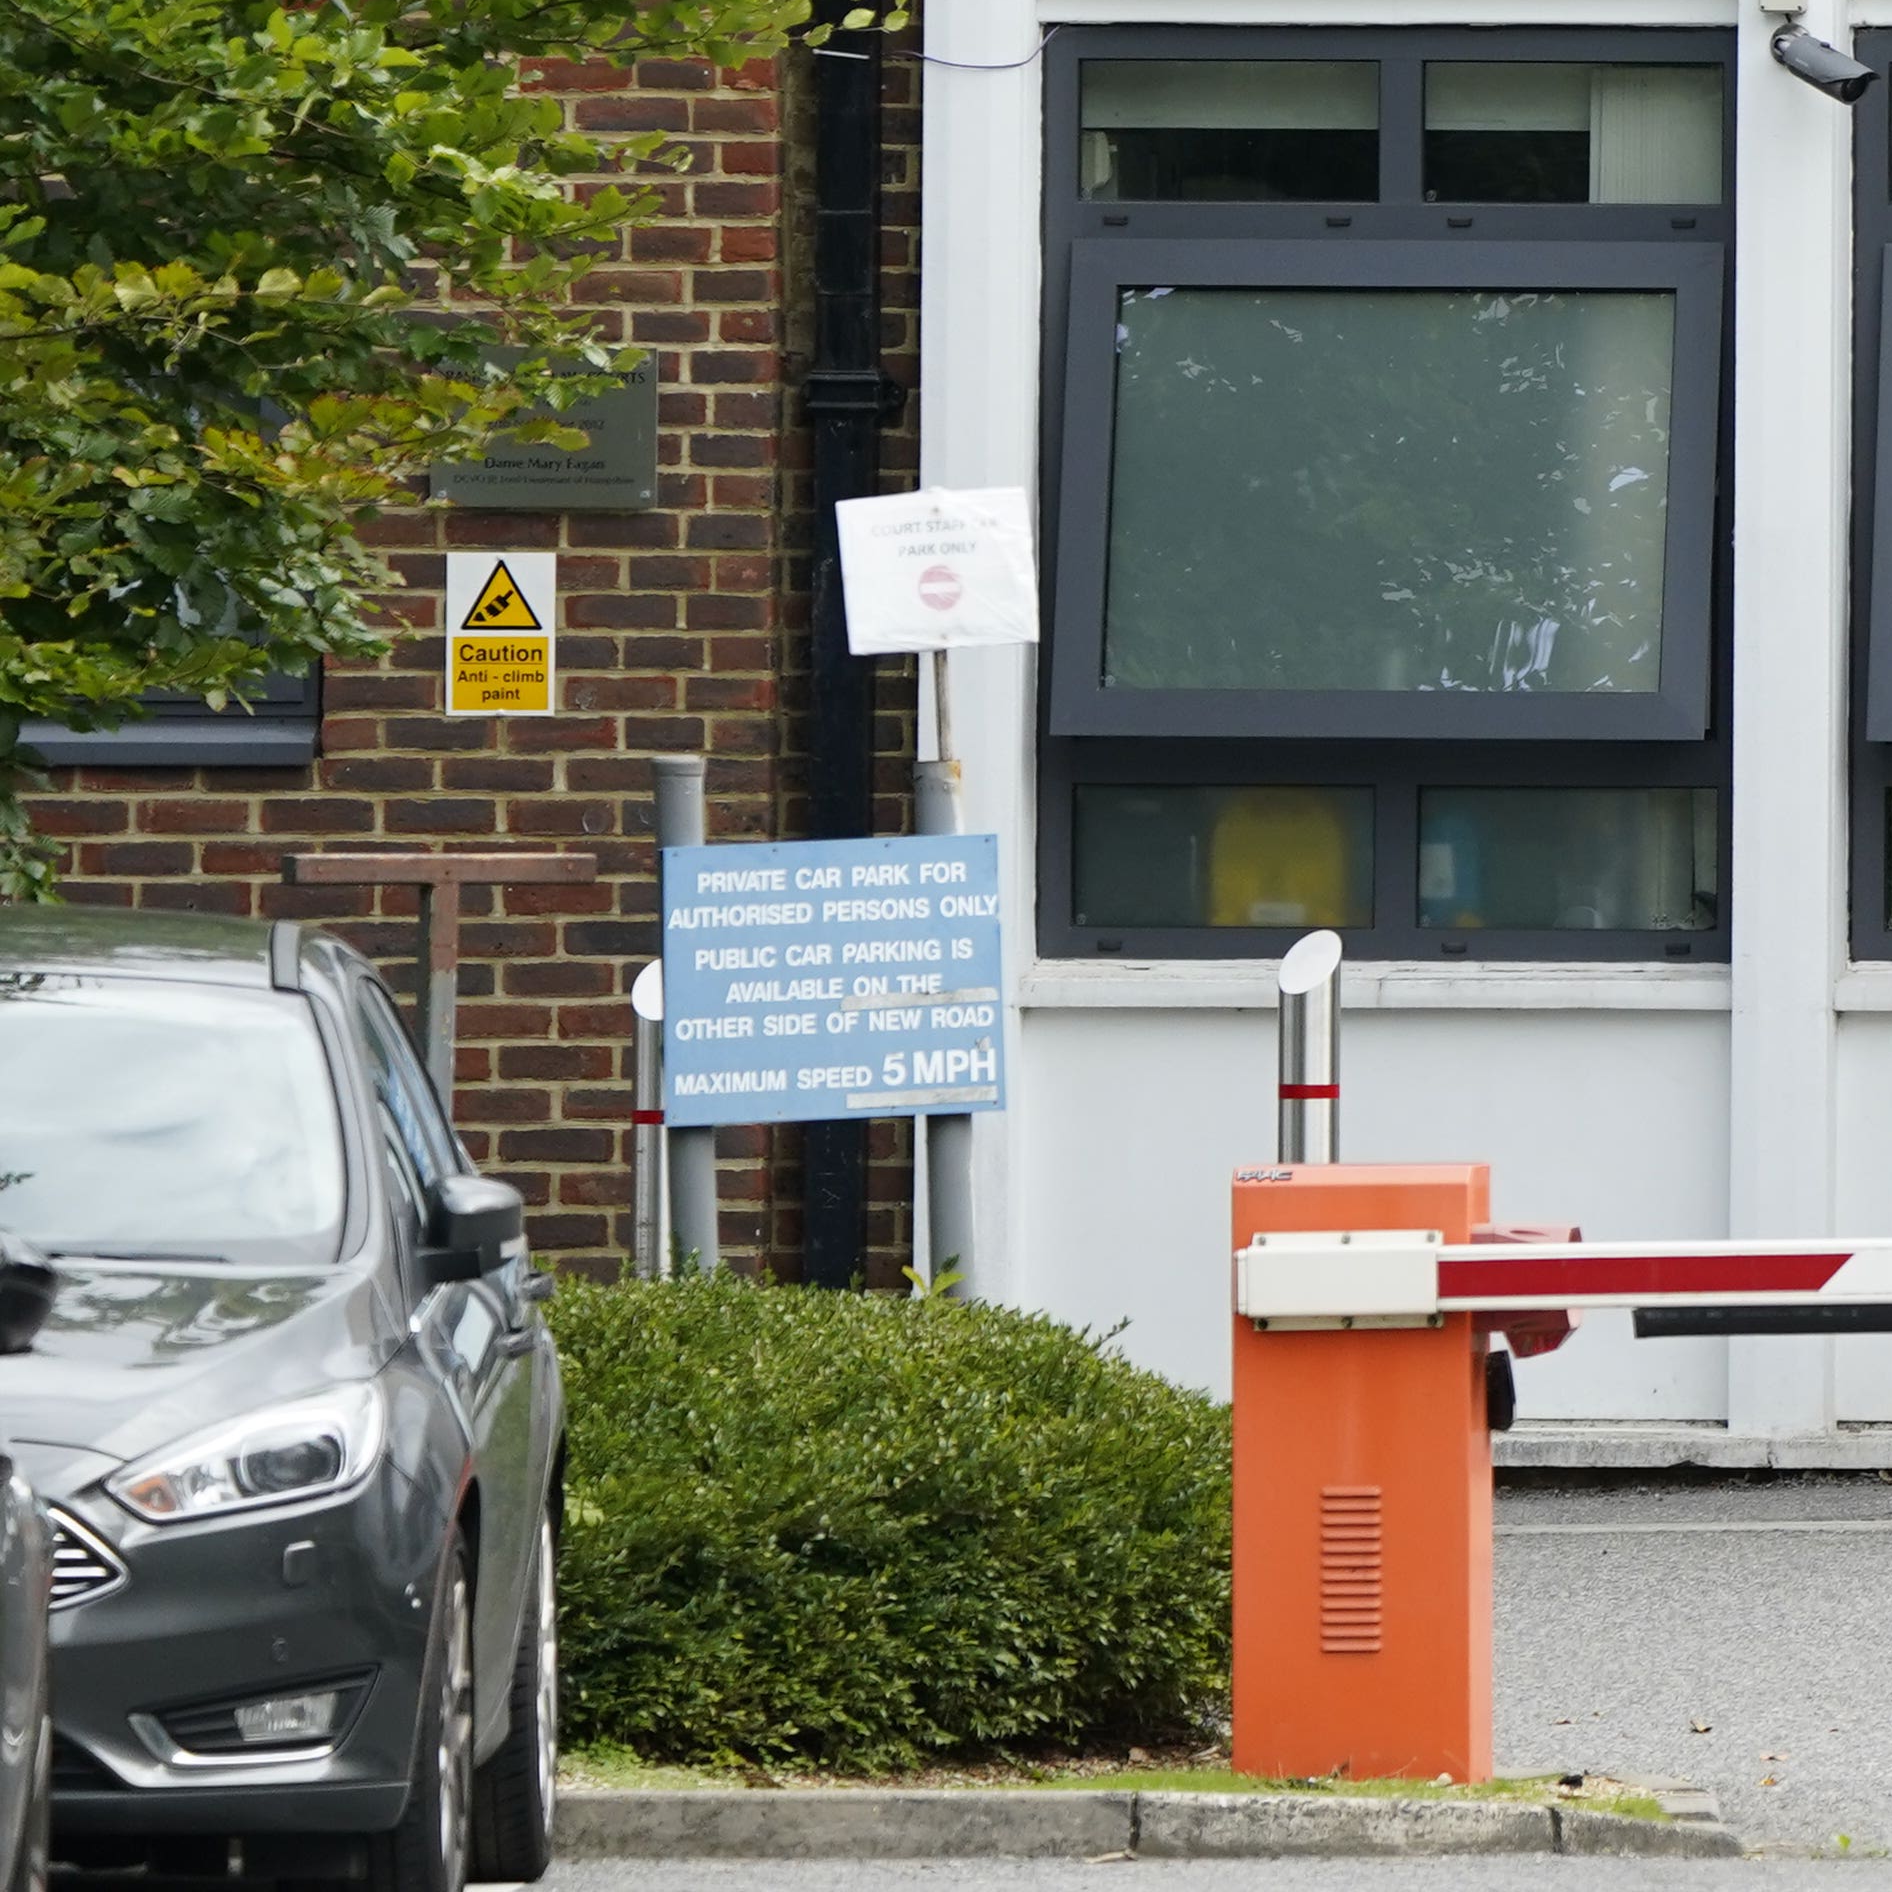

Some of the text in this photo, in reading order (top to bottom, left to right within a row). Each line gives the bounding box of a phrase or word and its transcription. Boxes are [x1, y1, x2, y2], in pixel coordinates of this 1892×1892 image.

[871, 521, 923, 537] COURT
[898, 541, 976, 557] PARK ONLY
[459, 643, 543, 663] Caution
[457, 669, 489, 683] Anti
[502, 669, 545, 684] climb
[481, 687, 521, 703] paint
[697, 861, 967, 894] PRIVATE CAR PARK FOR
[668, 894, 1000, 930] AUTHORISED PERSONS ONLY
[695, 937, 973, 971] PUBLIC CAR PARKING IS
[725, 973, 943, 1004] AVAILABLE ON THE
[675, 1004, 995, 1042] OTHER SIDE OF NEW ROAD
[674, 1047, 996, 1096] MAXIMUM SPEED 5 MPH
